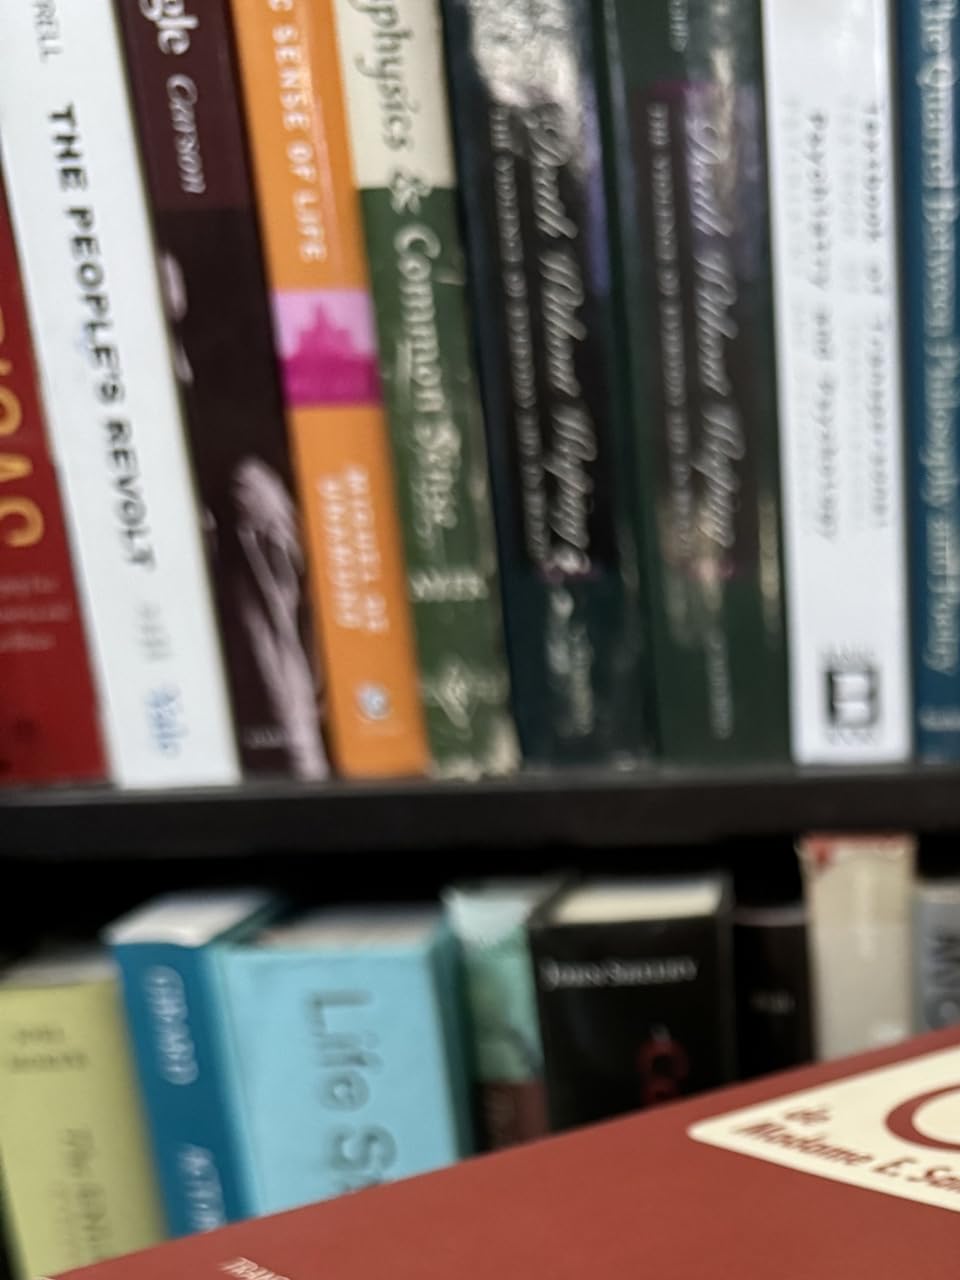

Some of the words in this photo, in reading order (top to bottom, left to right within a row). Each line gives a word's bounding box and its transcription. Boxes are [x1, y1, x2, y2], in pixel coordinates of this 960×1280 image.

[273, 26, 311, 132] SENSE
[49, 102, 87, 192] THE
[166, 74, 206, 194] Carson
[287, 140, 316, 183] OF
[294, 189, 328, 262] LIFE
[391, 165, 433, 215] &
[65, 204, 125, 405] PEOPLE'S
[394, 224, 446, 413] Common
[104, 416, 155, 570] REVOLT
[310, 990, 383, 1110] Life
[736, 1120, 872, 1167] Madame
